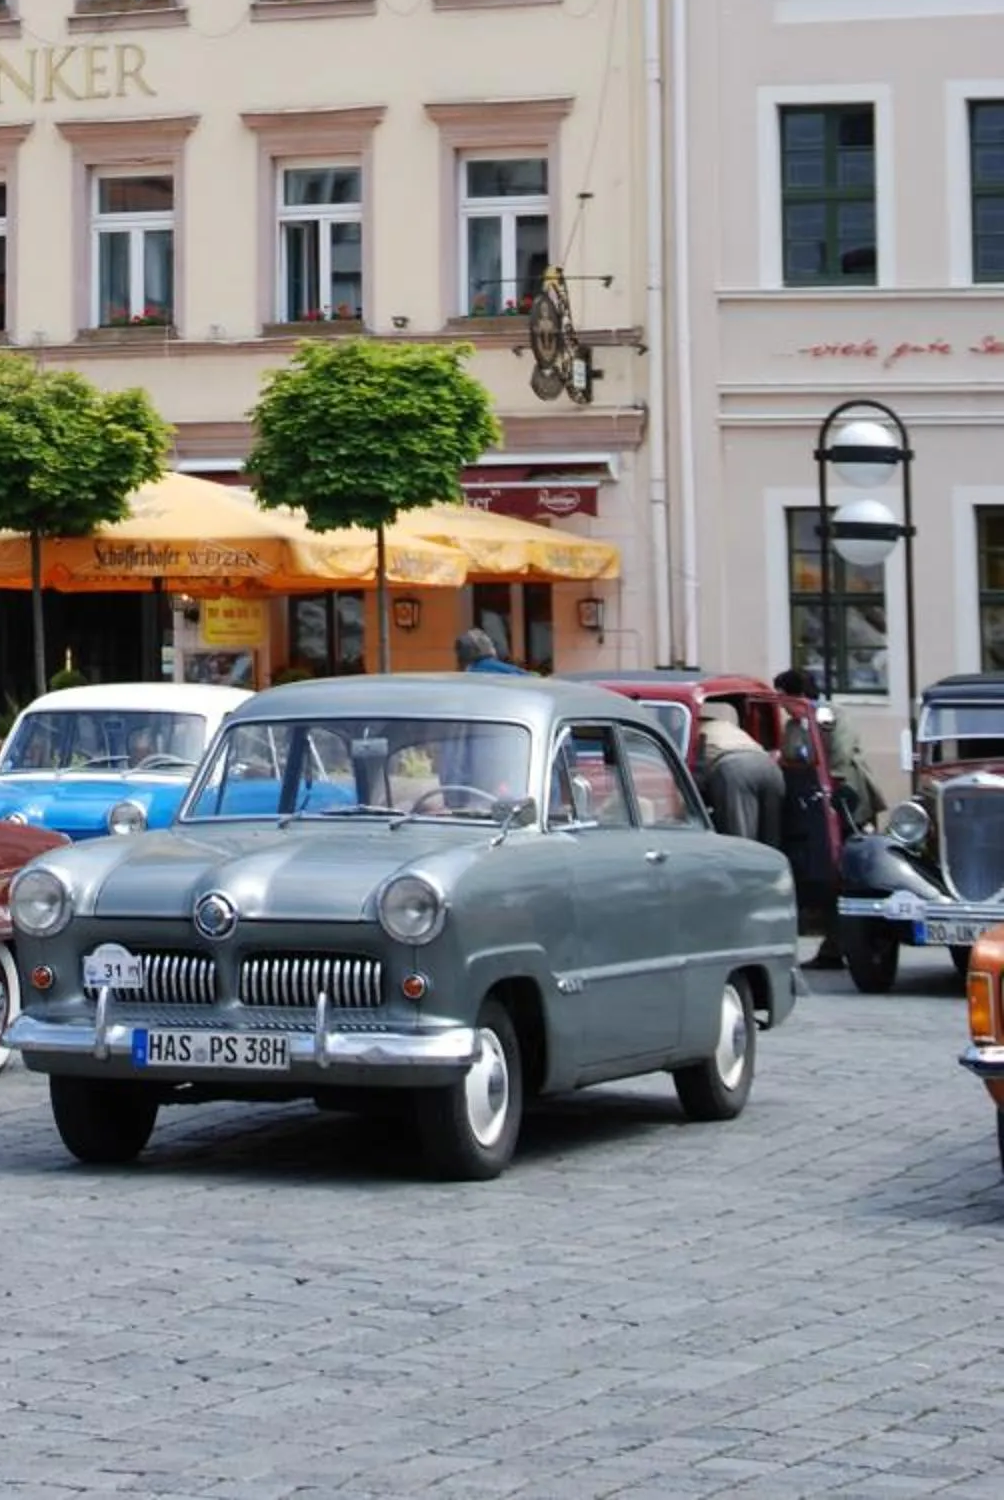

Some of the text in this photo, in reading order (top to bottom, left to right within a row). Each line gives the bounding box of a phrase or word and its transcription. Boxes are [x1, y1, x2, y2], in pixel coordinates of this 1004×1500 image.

[187, 548, 261, 567] WEIZEN
[103, 963, 121, 978] 31
[149, 1033, 286, 1066] HAS PS 38H
